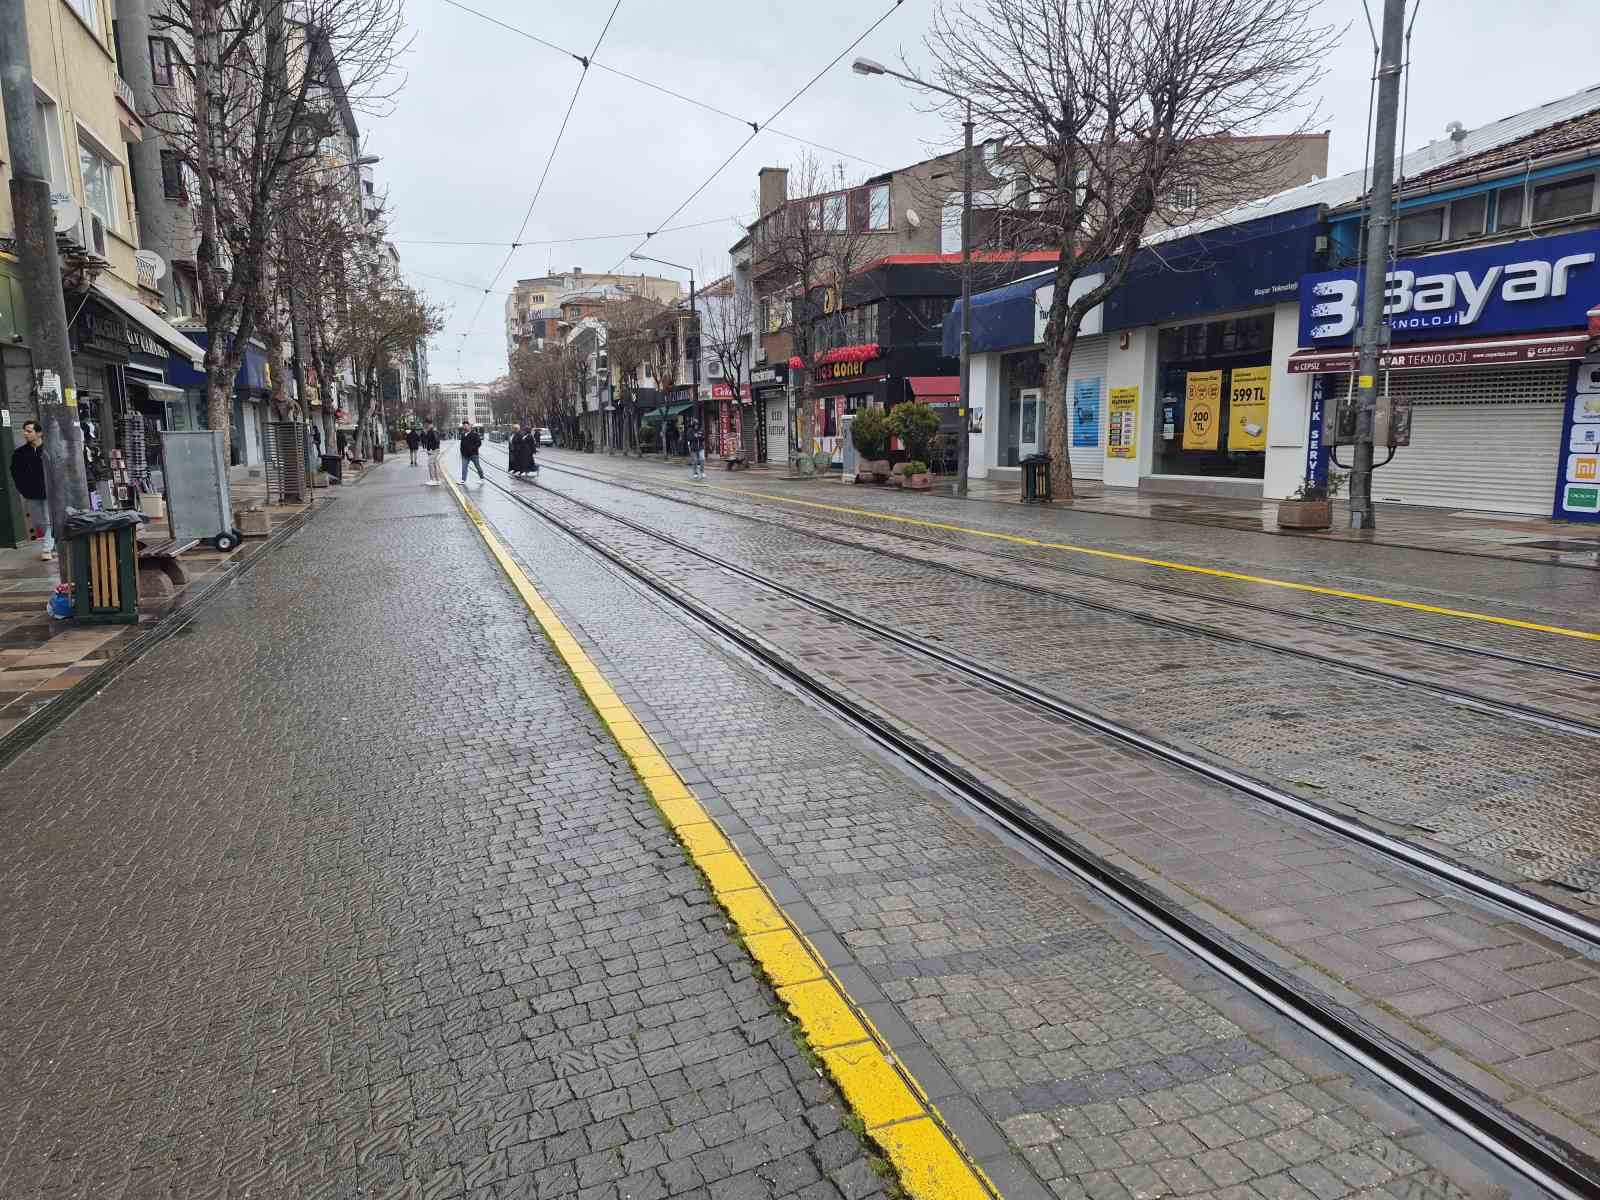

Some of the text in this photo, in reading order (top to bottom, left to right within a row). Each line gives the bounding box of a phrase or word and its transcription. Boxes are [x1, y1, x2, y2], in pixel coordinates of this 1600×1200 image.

[1383, 253, 1595, 325] Bayar
[1233, 388, 1252, 402] 599
[1253, 387, 1266, 401] TL
[1193, 411, 1209, 422] 200
[1196, 422, 1205, 431] TL
